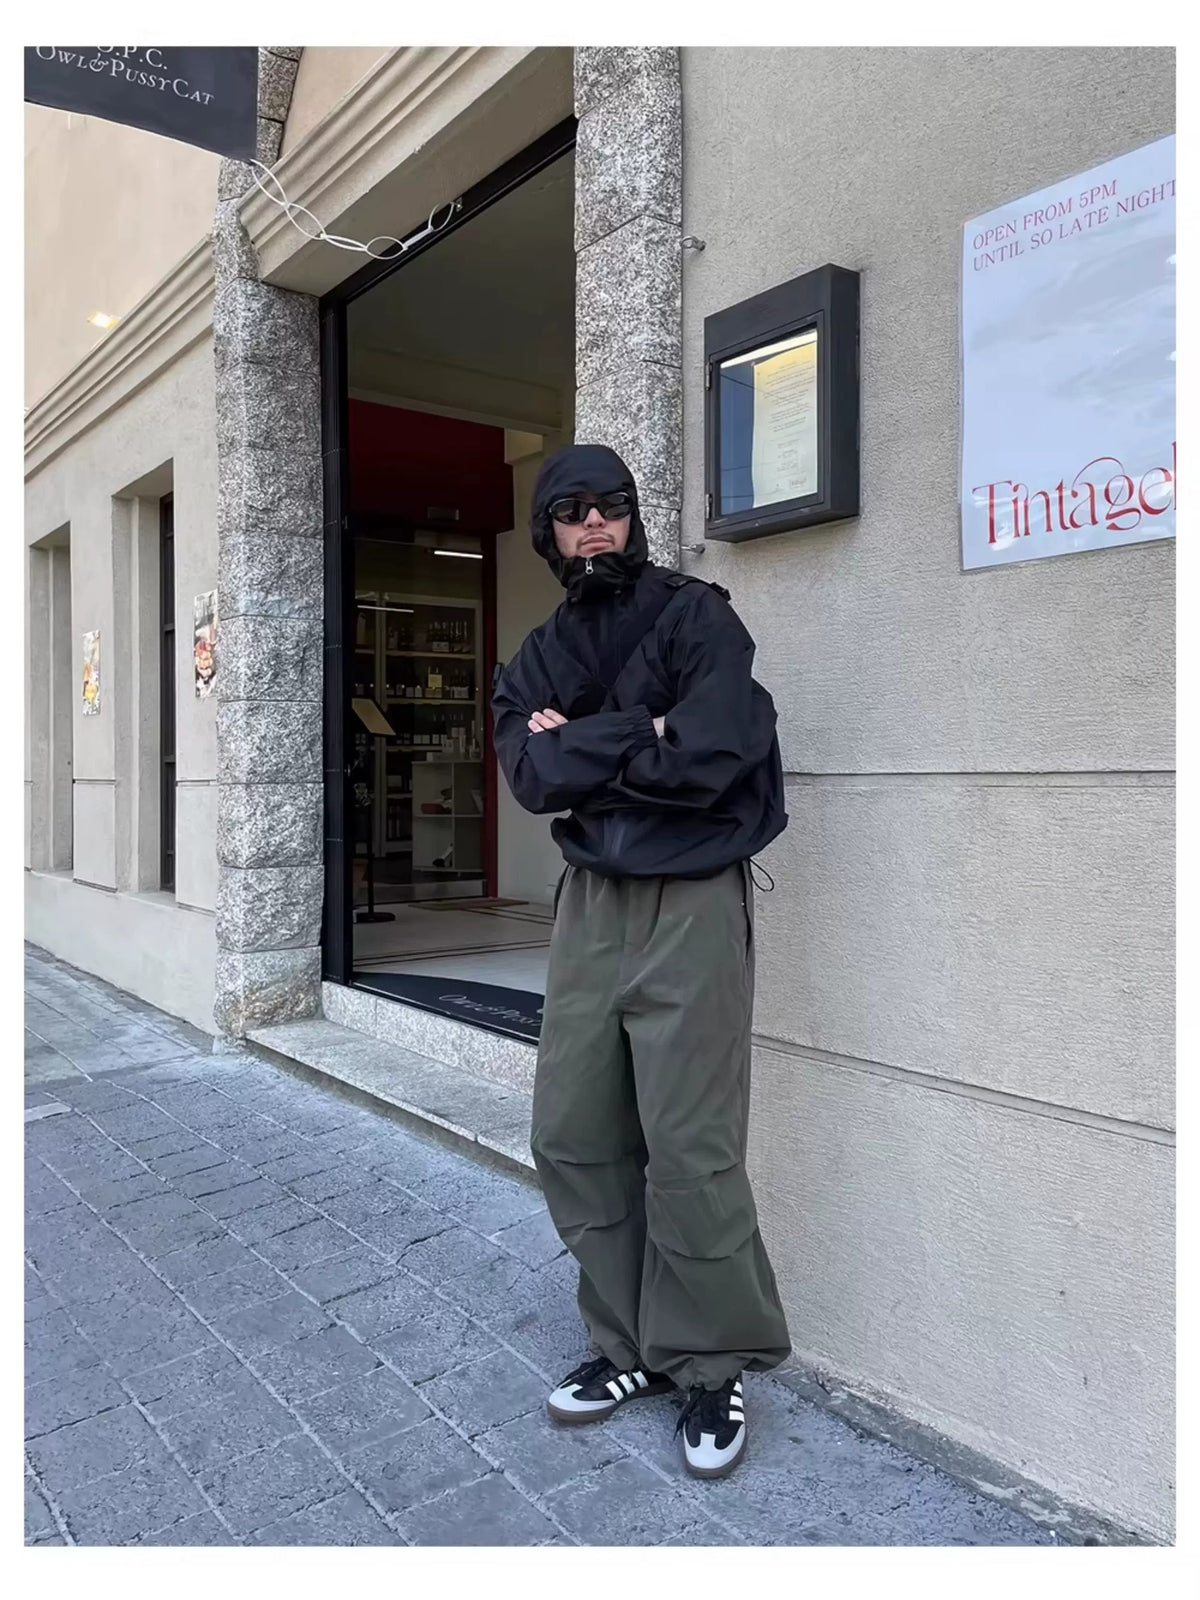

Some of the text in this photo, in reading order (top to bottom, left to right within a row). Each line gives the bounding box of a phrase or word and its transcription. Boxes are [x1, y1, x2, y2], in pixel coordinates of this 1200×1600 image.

[972, 179, 1118, 250] OPEN FROM 5PM
[972, 178, 1177, 272] UNTIL SO LATE NIGHT
